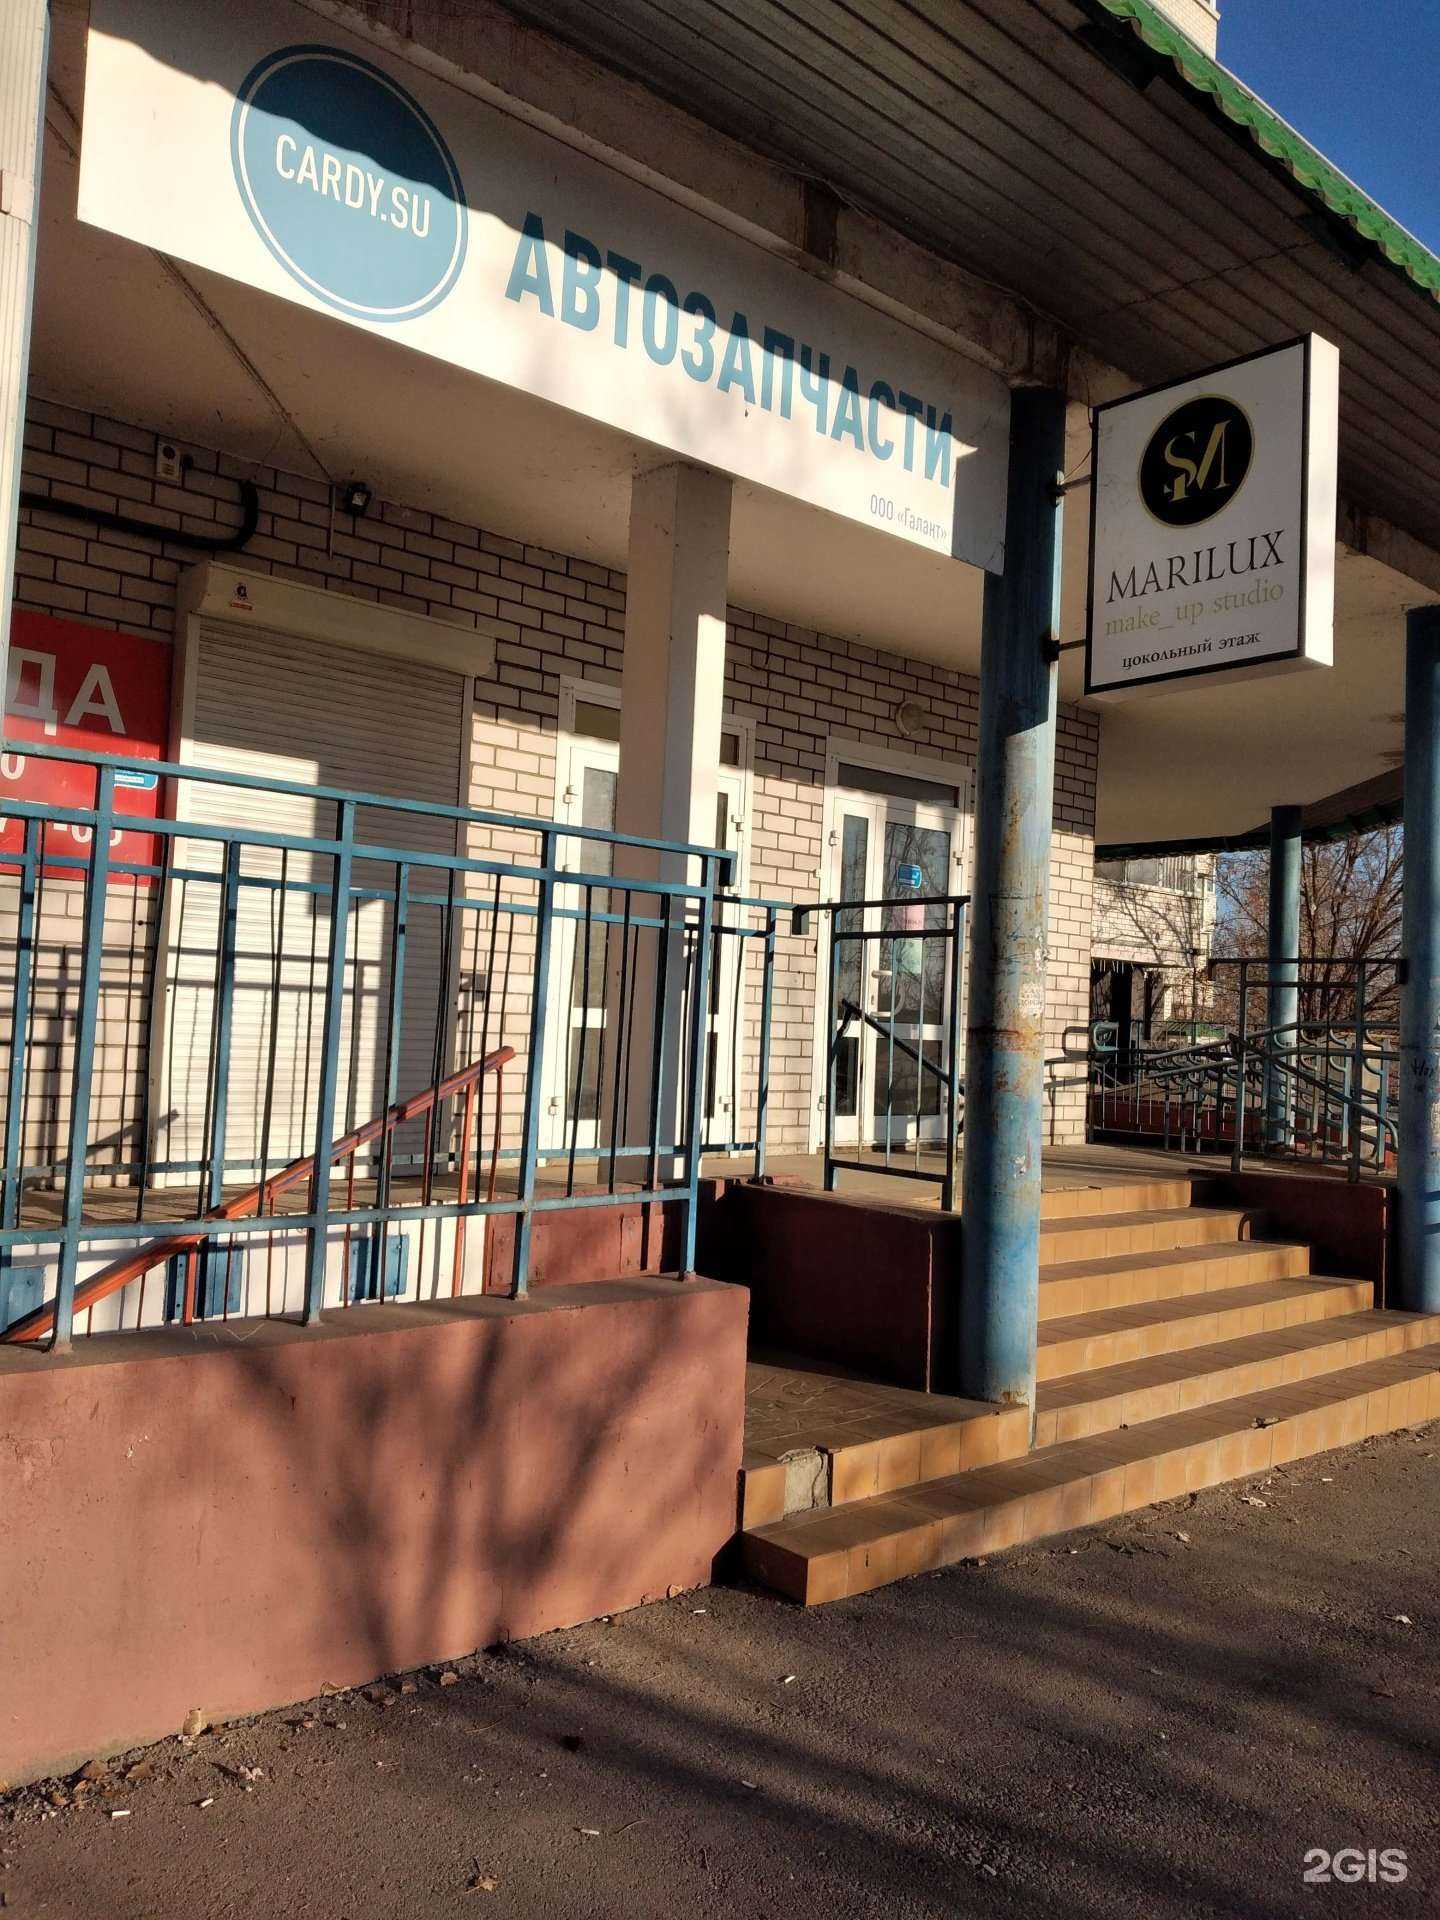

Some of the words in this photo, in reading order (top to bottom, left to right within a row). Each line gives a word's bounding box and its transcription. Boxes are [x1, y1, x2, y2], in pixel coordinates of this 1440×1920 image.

[275, 133, 431, 238] CARDY.SU
[504, 210, 953, 489] АВТОЗАПЧАСТИ
[870, 493, 894, 521] ООО
[897, 506, 948, 539] «Галант»
[1105, 529, 1286, 604] MARILUX
[1104, 598, 1205, 637] make_up
[1212, 577, 1285, 617] studio
[1121, 638, 1213, 671] цокольный
[1218, 630, 1262, 651] этаж
